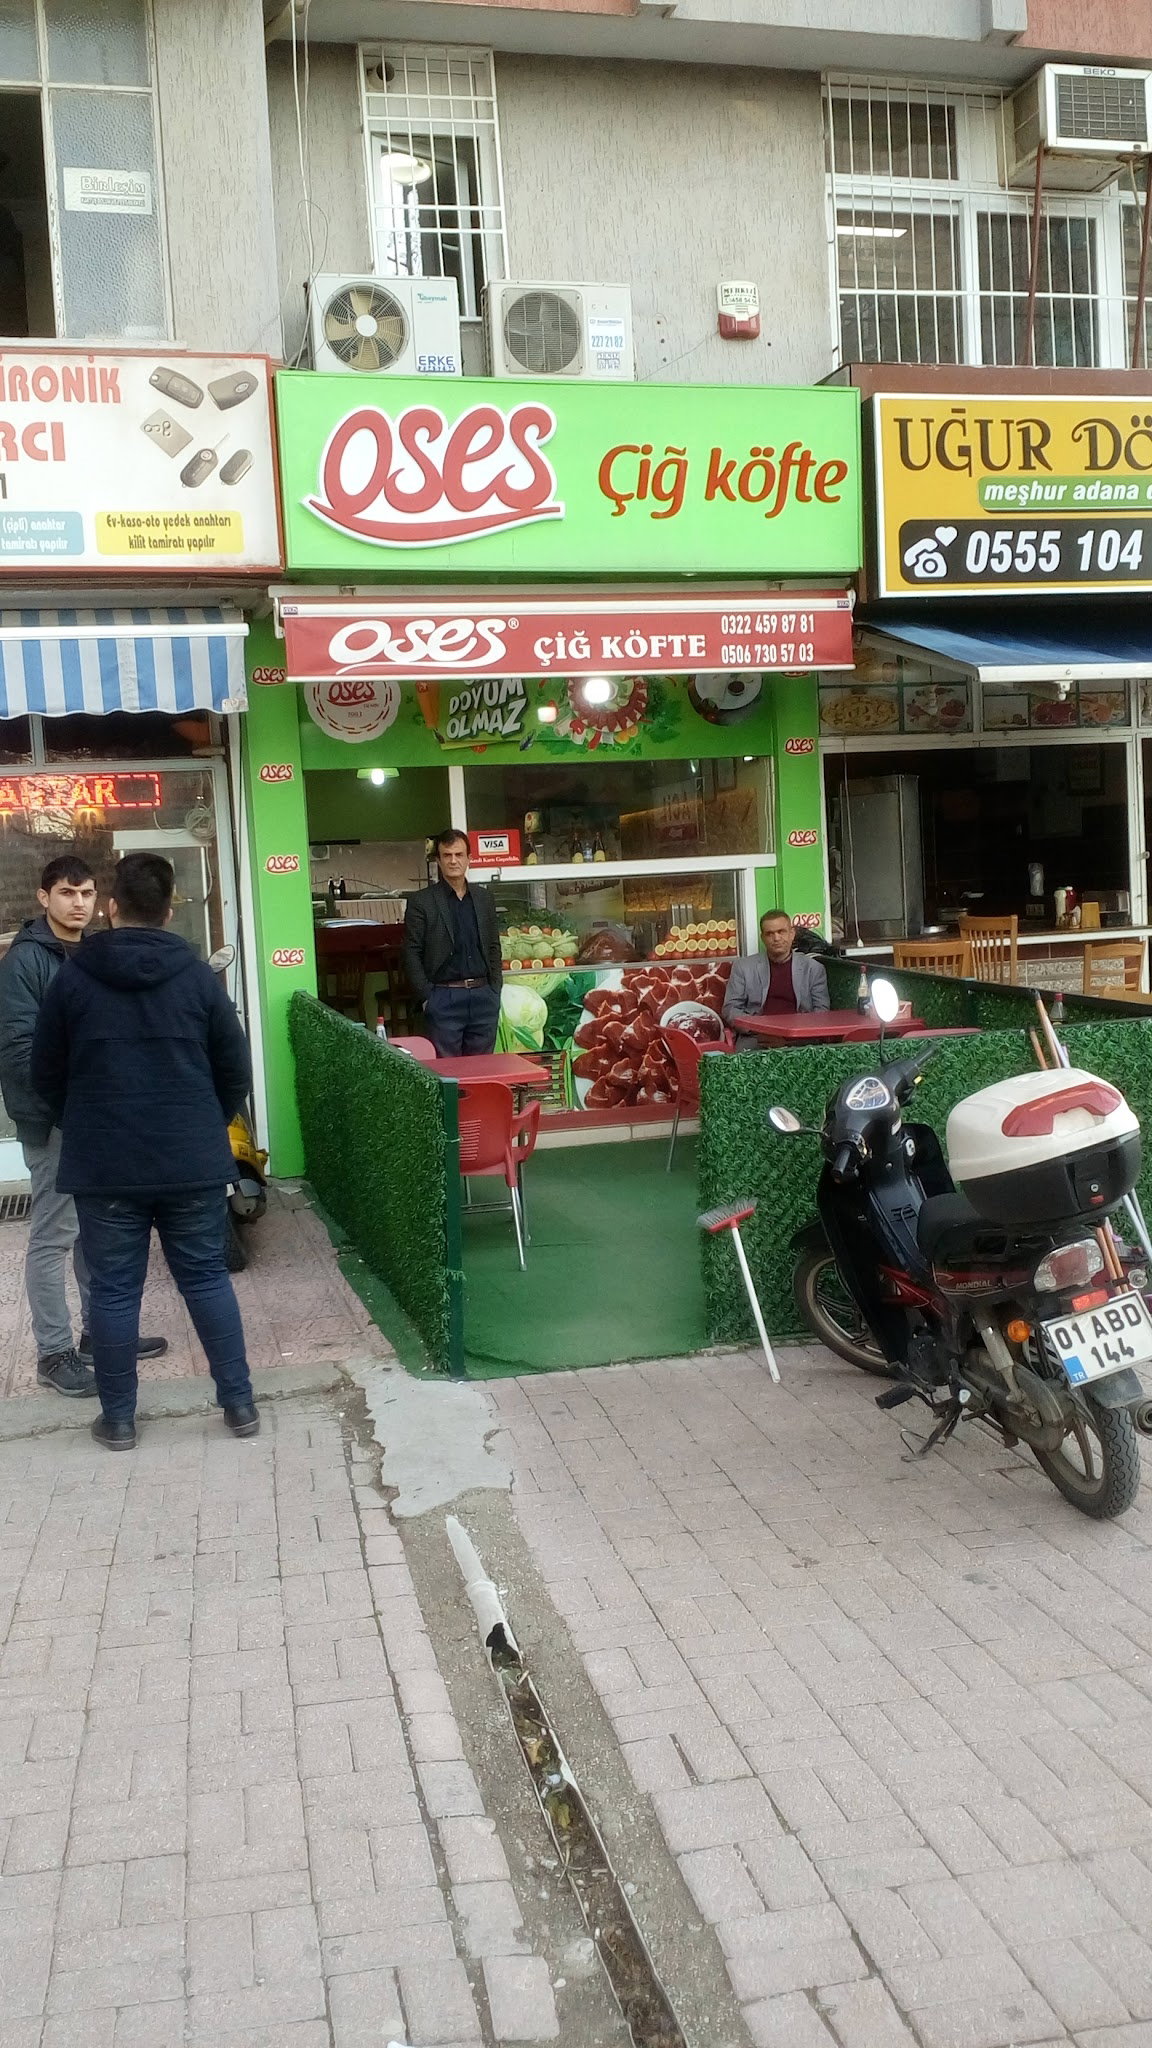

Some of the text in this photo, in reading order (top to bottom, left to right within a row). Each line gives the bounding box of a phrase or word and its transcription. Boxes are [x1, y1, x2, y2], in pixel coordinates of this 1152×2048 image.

[1083, 68, 1116, 76] BEKO
[418, 355, 454, 366] ERKE
[598, 441, 848, 519] Çiğ köfte
[983, 481, 1068, 507] meşhur
[1072, 480, 1140, 501] adana
[30, 517, 66, 531] anahtar
[163, 513, 191, 531] yedek
[193, 513, 232, 528] anahtarı
[39, 537, 68, 553] yapılır
[149, 535, 184, 549] tamiratı
[186, 535, 215, 552] yapılır
[965, 529, 1144, 574] 0555 104
[721, 614, 814, 635] 0322 459 87 81
[533, 629, 707, 667] ÇİĞ KÖFTE
[721, 643, 814, 664] 0506 730 57 03
[449, 678, 525, 716] DOYUM
[446, 698, 527, 739] OLMAZ
[484, 840, 504, 849] VISA
[955, 1280, 993, 1290] MONDIAL
[1055, 1303, 1142, 1350] 01 ABD
[1091, 1337, 1135, 1369] 144
[1073, 1372, 1086, 1381] TR
